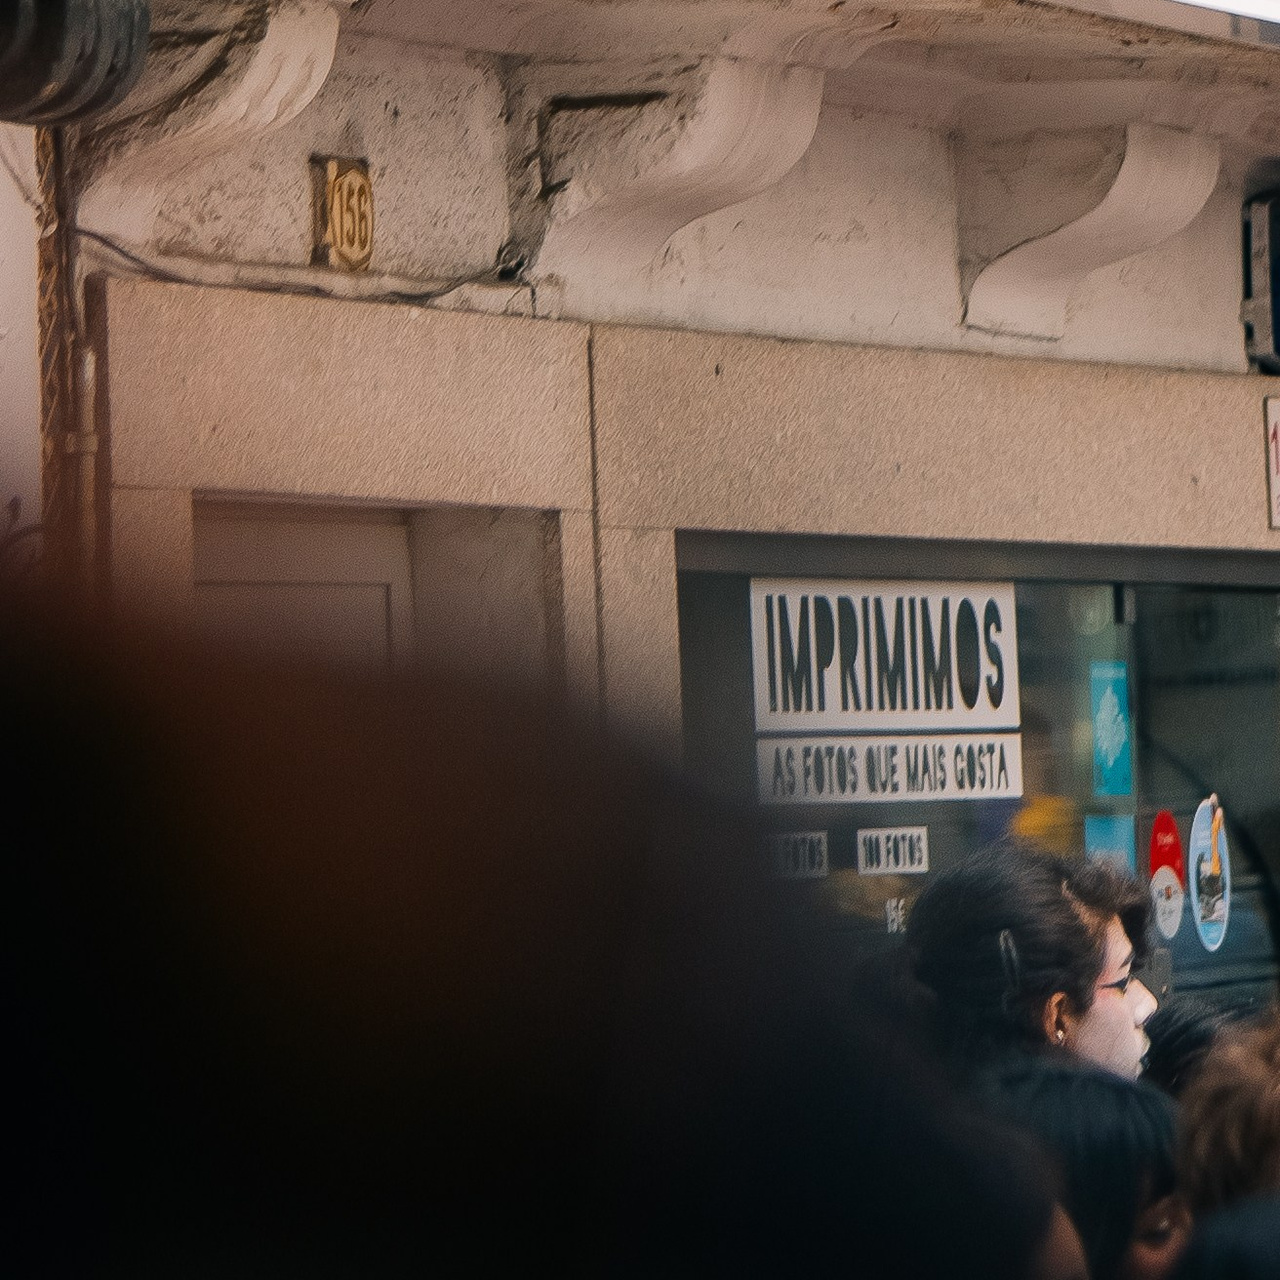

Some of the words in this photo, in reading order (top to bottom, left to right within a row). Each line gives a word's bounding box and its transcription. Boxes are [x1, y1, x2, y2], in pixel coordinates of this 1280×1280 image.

[335, 178, 369, 252] 156
[764, 593, 1006, 714] IMPRIMIMOS
[773, 745, 796, 795] AS
[802, 744, 858, 795] FOTOS
[865, 744, 899, 795] QUE
[905, 743, 947, 794] MAIS
[953, 742, 1009, 791] GOSTA
[885, 833, 923, 869] FOTOS
